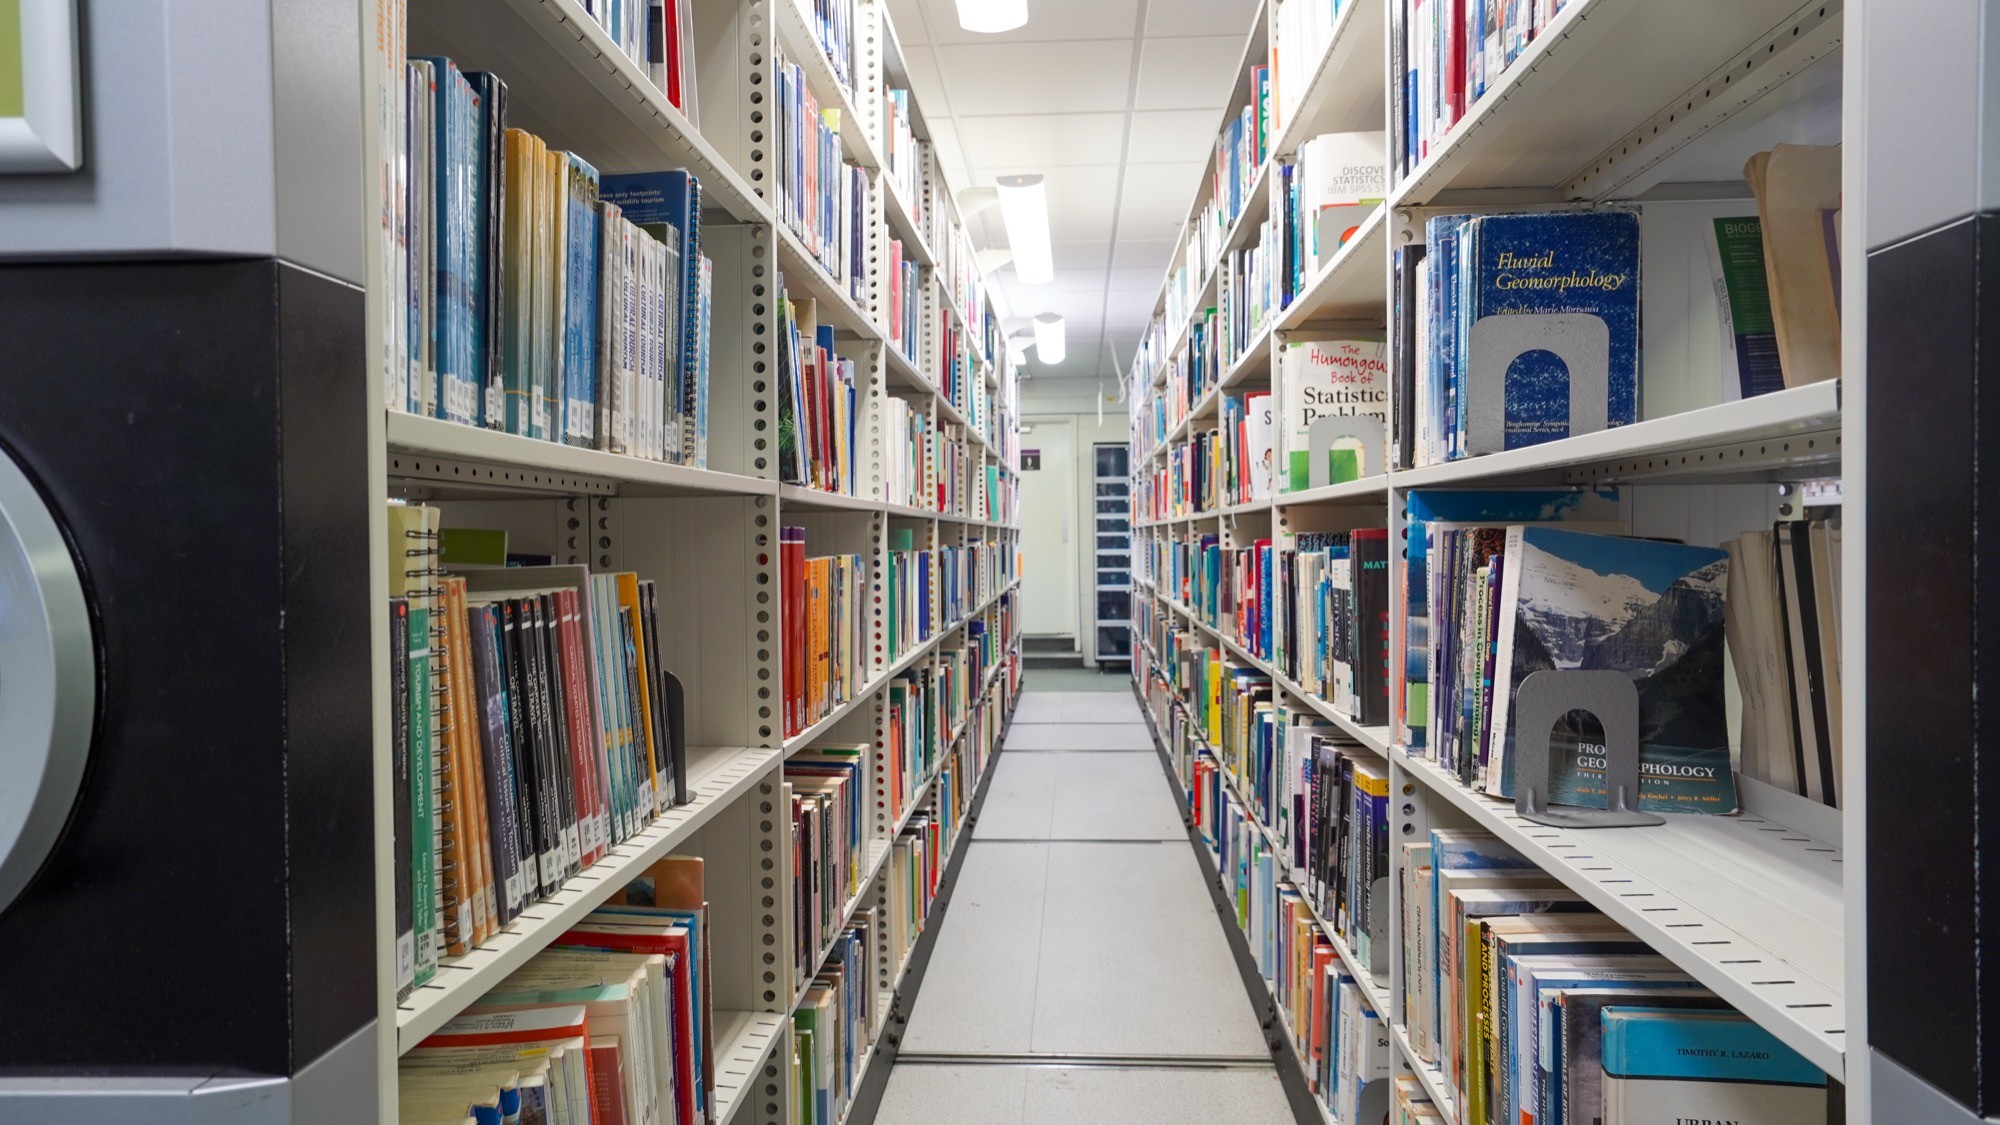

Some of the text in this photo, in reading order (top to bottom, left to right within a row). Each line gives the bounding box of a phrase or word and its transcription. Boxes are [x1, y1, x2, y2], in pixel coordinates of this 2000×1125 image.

[1333, 175, 1386, 185] STATISTICS
[1350, 185, 1373, 194] SPSS
[1497, 250, 1554, 270] Fluvial
[1496, 269, 1625, 292] Geomorphology
[1534, 304, 1558, 314] Marie
[1341, 345, 1360, 355] The
[1331, 371, 1374, 384] Book of
[569, 646, 577, 681] CRITICAL
[1473, 575, 1486, 746] Process in Geomorphology
[399, 618, 409, 780] Contemporary Tourist Experience
[509, 676, 519, 732] OF TRAVEL
[527, 673, 537, 728] OF TRAVEL
[539, 671, 548, 726] OF TRAVEL
[572, 685, 580, 718] DEBATES
[414, 663, 425, 819] TOURISM AND DEVELOPMENT
[576, 720, 581, 729] IN
[504, 733, 513, 772] Critical
[498, 736, 517, 875] Critical Issues in Tourism
[1481, 943, 1490, 1040] AND PROCESSES
[1500, 967, 1510, 1121] Coastal Geomorphology
[1676, 1048, 1770, 1060] TIMOTHY R. LAZARO
[1562, 1084, 1568, 1098] OF
